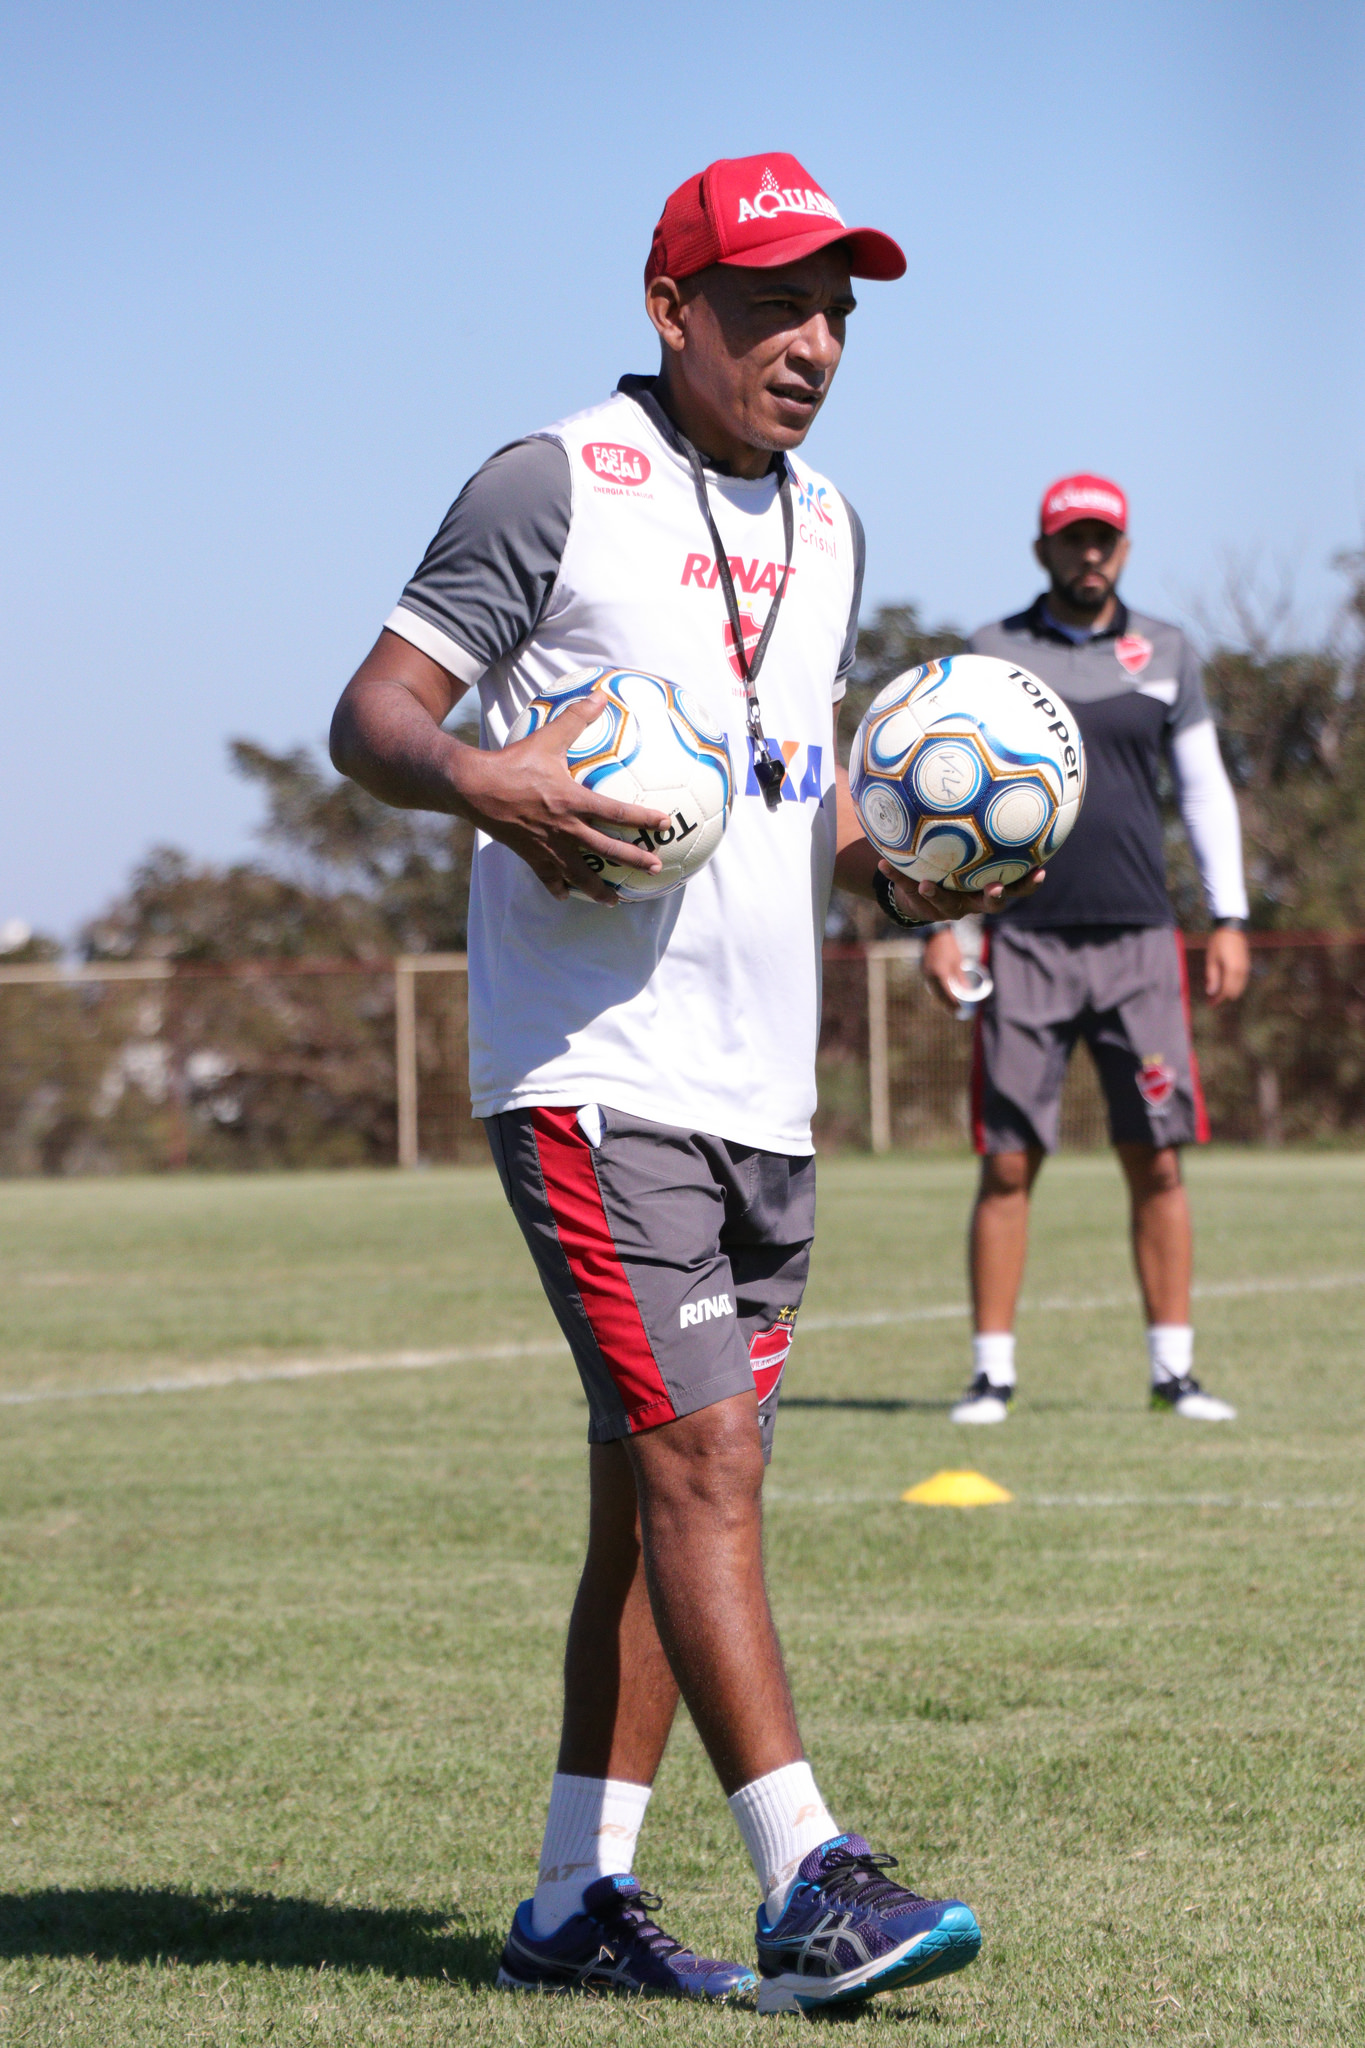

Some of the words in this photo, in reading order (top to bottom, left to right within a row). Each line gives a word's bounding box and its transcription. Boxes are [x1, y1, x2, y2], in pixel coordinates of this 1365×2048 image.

[592, 446, 626, 463] FAST
[680, 552, 797, 599] RINAT
[1008, 666, 1079, 783] Topper
[680, 1293, 734, 1329] RINAT
